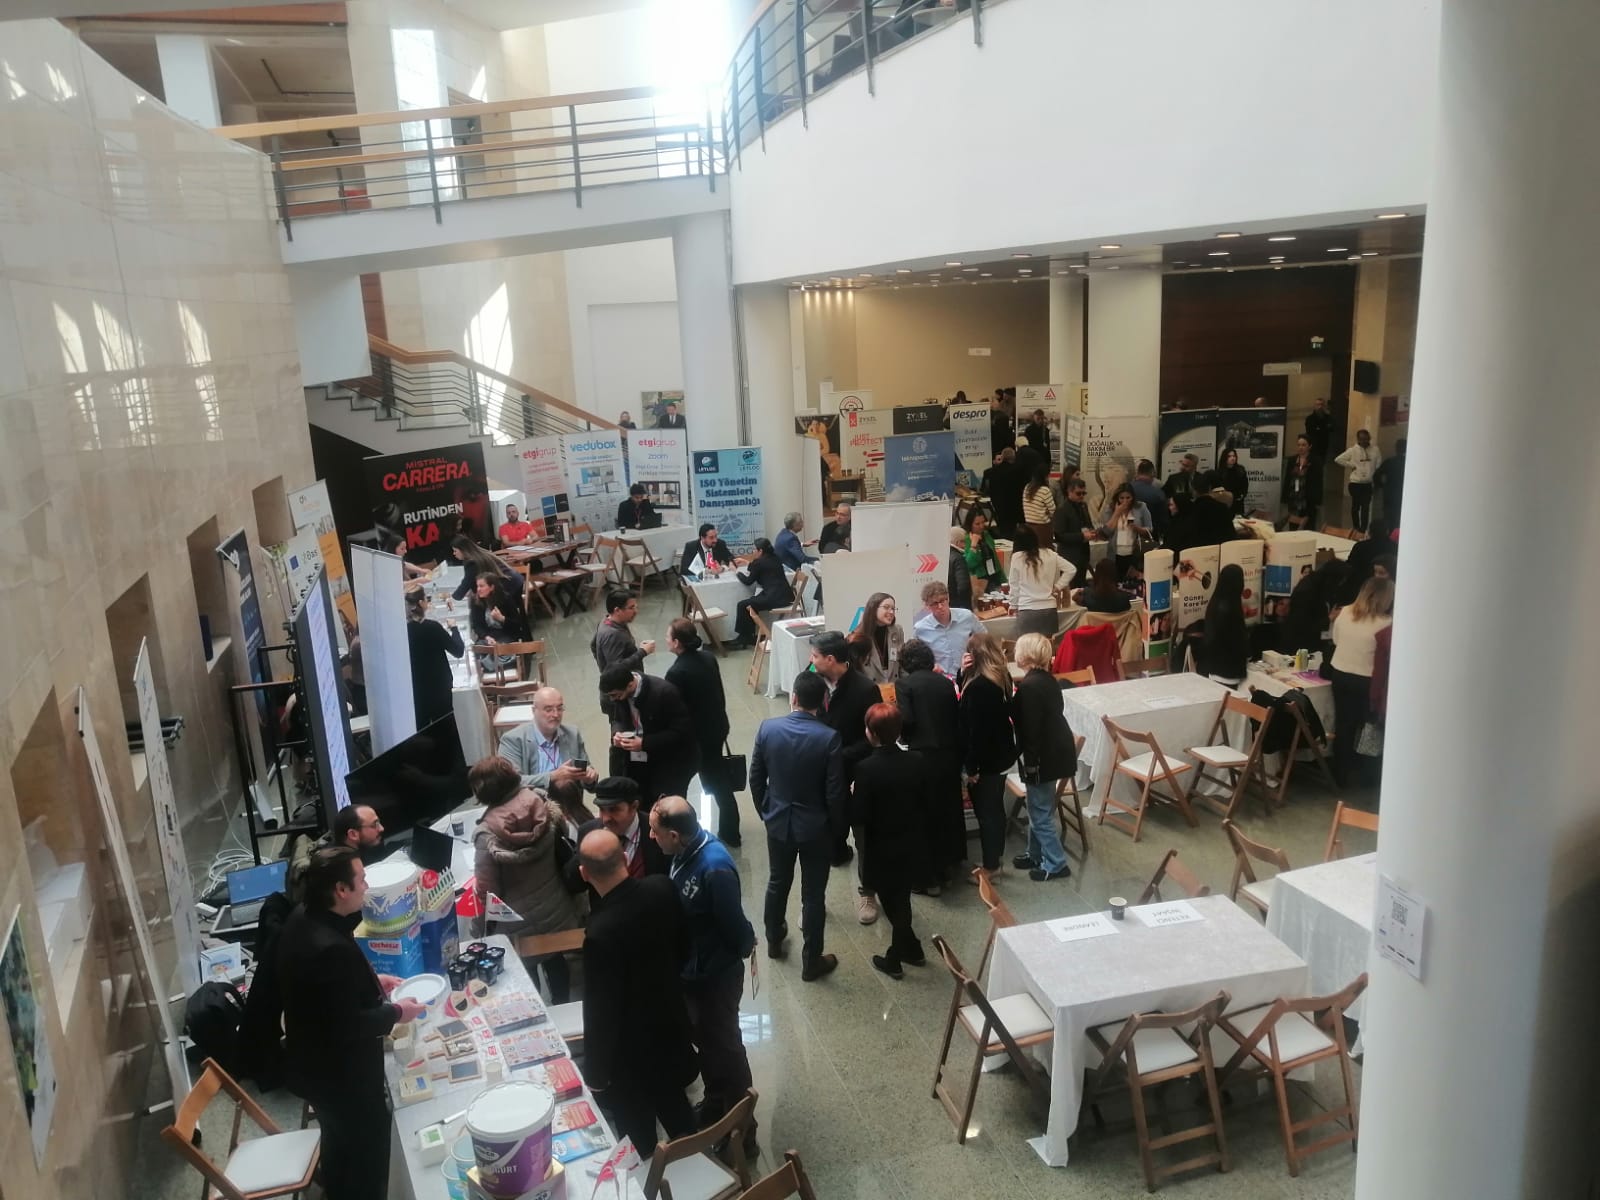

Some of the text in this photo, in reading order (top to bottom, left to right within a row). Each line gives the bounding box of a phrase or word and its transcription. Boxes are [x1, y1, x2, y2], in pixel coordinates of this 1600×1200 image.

[953, 410, 987, 420] despro
[570, 440, 617, 452] vedubox
[522, 447, 558, 460] etgigrup
[382, 461, 471, 492] CARRERA
[700, 477, 757, 488] ISO Yönetim
[705, 487, 753, 498] Sistemleri
[699, 497, 760, 509] Danışmanlığı
[403, 502, 464, 525] RUTİNDEN
